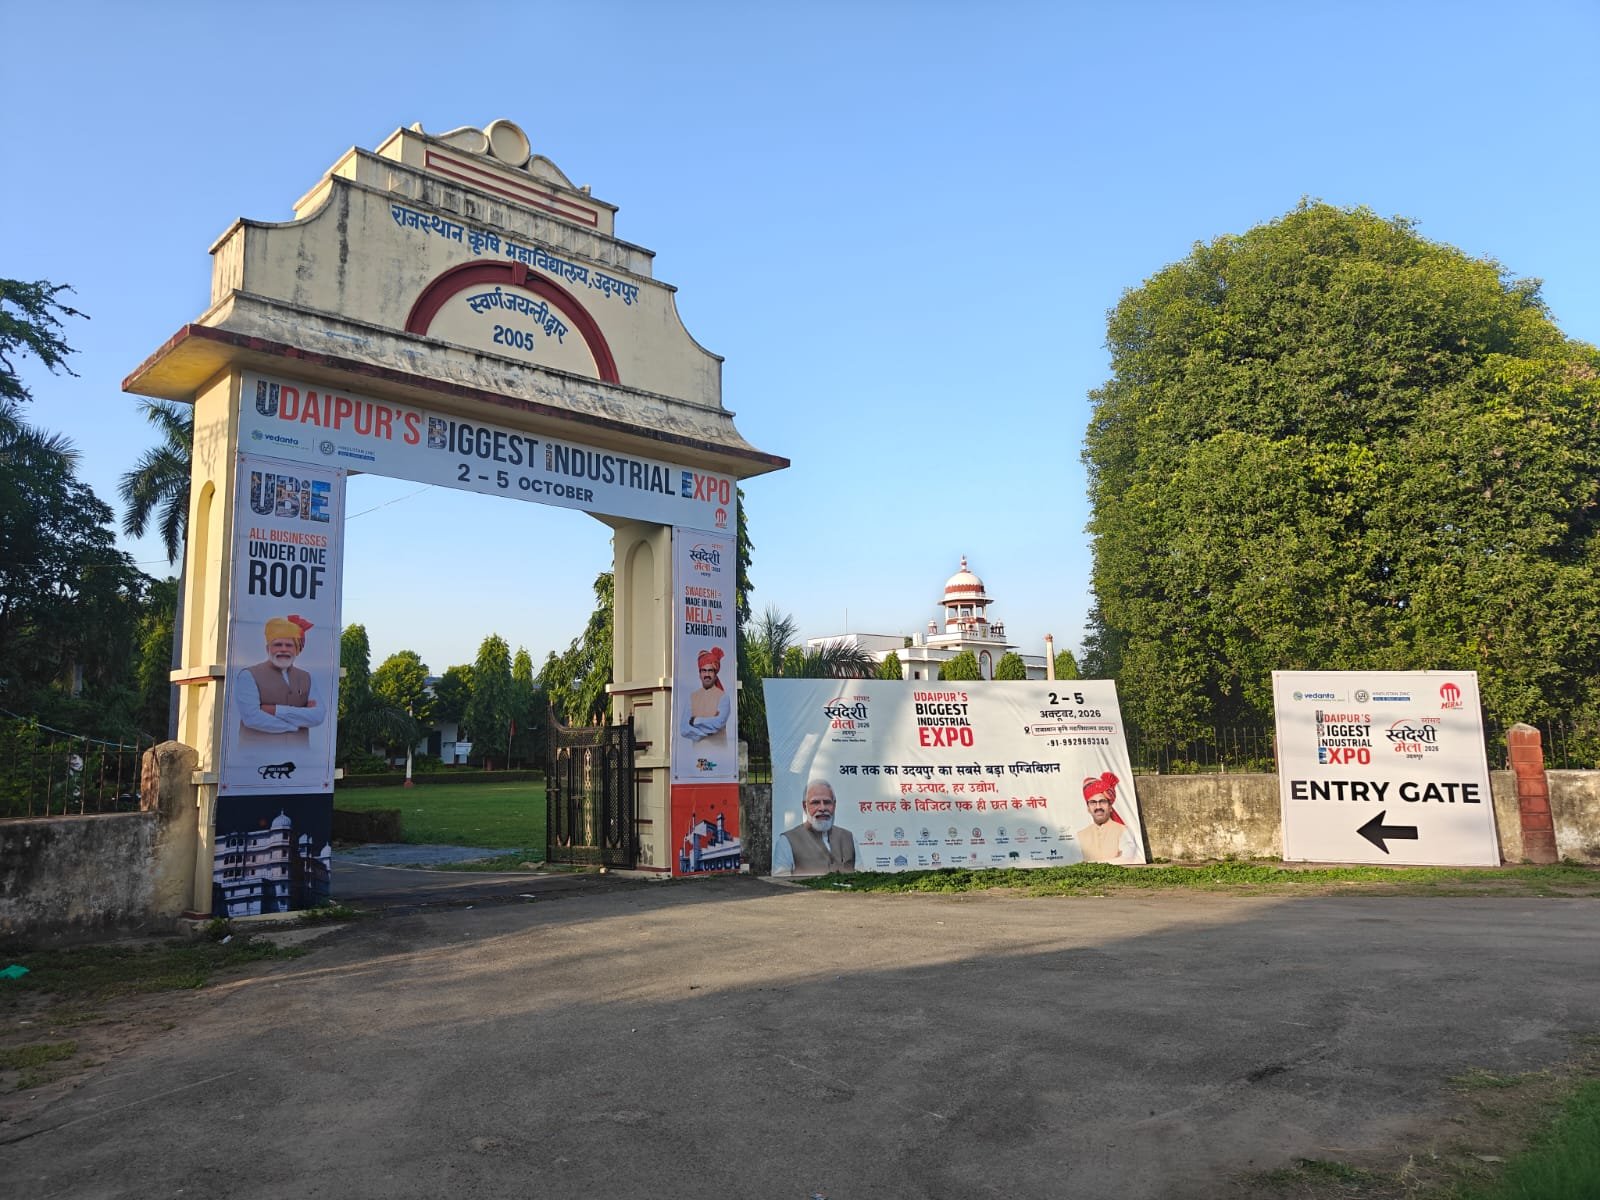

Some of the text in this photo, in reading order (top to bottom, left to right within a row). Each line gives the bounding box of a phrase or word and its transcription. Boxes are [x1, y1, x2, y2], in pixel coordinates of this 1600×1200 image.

[392, 204, 464, 242] राजस्थान
[468, 230, 500, 256] कृषि
[493, 324, 534, 351] 2005
[256, 380, 421, 445] UDAIPUR'S
[427, 416, 538, 468] BIGGEST
[681, 471, 730, 506] EXPO
[265, 432, 299, 445] vedanta
[457, 463, 471, 482] 2
[497, 470, 509, 489] 5
[518, 476, 594, 503] OCTOBER
[249, 527, 327, 547] ALL BUSINESSES
[249, 541, 326, 565] UNDER ONE
[689, 548, 720, 566] स्वदेशी
[248, 559, 326, 600] ROOF
[685, 586, 717, 598] SWADESHI
[685, 597, 722, 609] MADE IN INDIA
[685, 606, 713, 624] MELA
[685, 623, 727, 638] EXHIBITION
[914, 691, 968, 702] UDAIPUR'S
[1048, 692, 1059, 705] 2
[1073, 692, 1084, 705] 5
[1305, 691, 1335, 699] vedanta
[824, 703, 868, 720] स्वदेशी
[916, 703, 968, 715] BIGGEST
[1078, 709, 1101, 718] 2026
[1316, 710, 1371, 724] UDAIPUR'S
[832, 717, 855, 730] मेला
[917, 717, 971, 726] INDUSTRIAL
[919, 727, 974, 747] EXPO
[1316, 724, 1371, 737] BIGGEST
[1385, 724, 1438, 743] स्वदेशी
[1394, 740, 1421, 753] मेला
[1318, 747, 1371, 764] EXPO
[839, 765, 858, 775] अब
[861, 765, 880, 775] तक
[883, 765, 898, 775] का
[902, 765, 934, 779] उदयपुर
[938, 765, 952, 775] का
[956, 761, 981, 776] सबसे
[900, 783, 913, 795] हर
[916, 783, 949, 795] उत्पाद,
[952, 783, 965, 795] हर
[1291, 780, 1481, 804] ENTRY GATE
[859, 796, 1047, 813] हर तरह के विजिटर एक ही छत के नीचे
